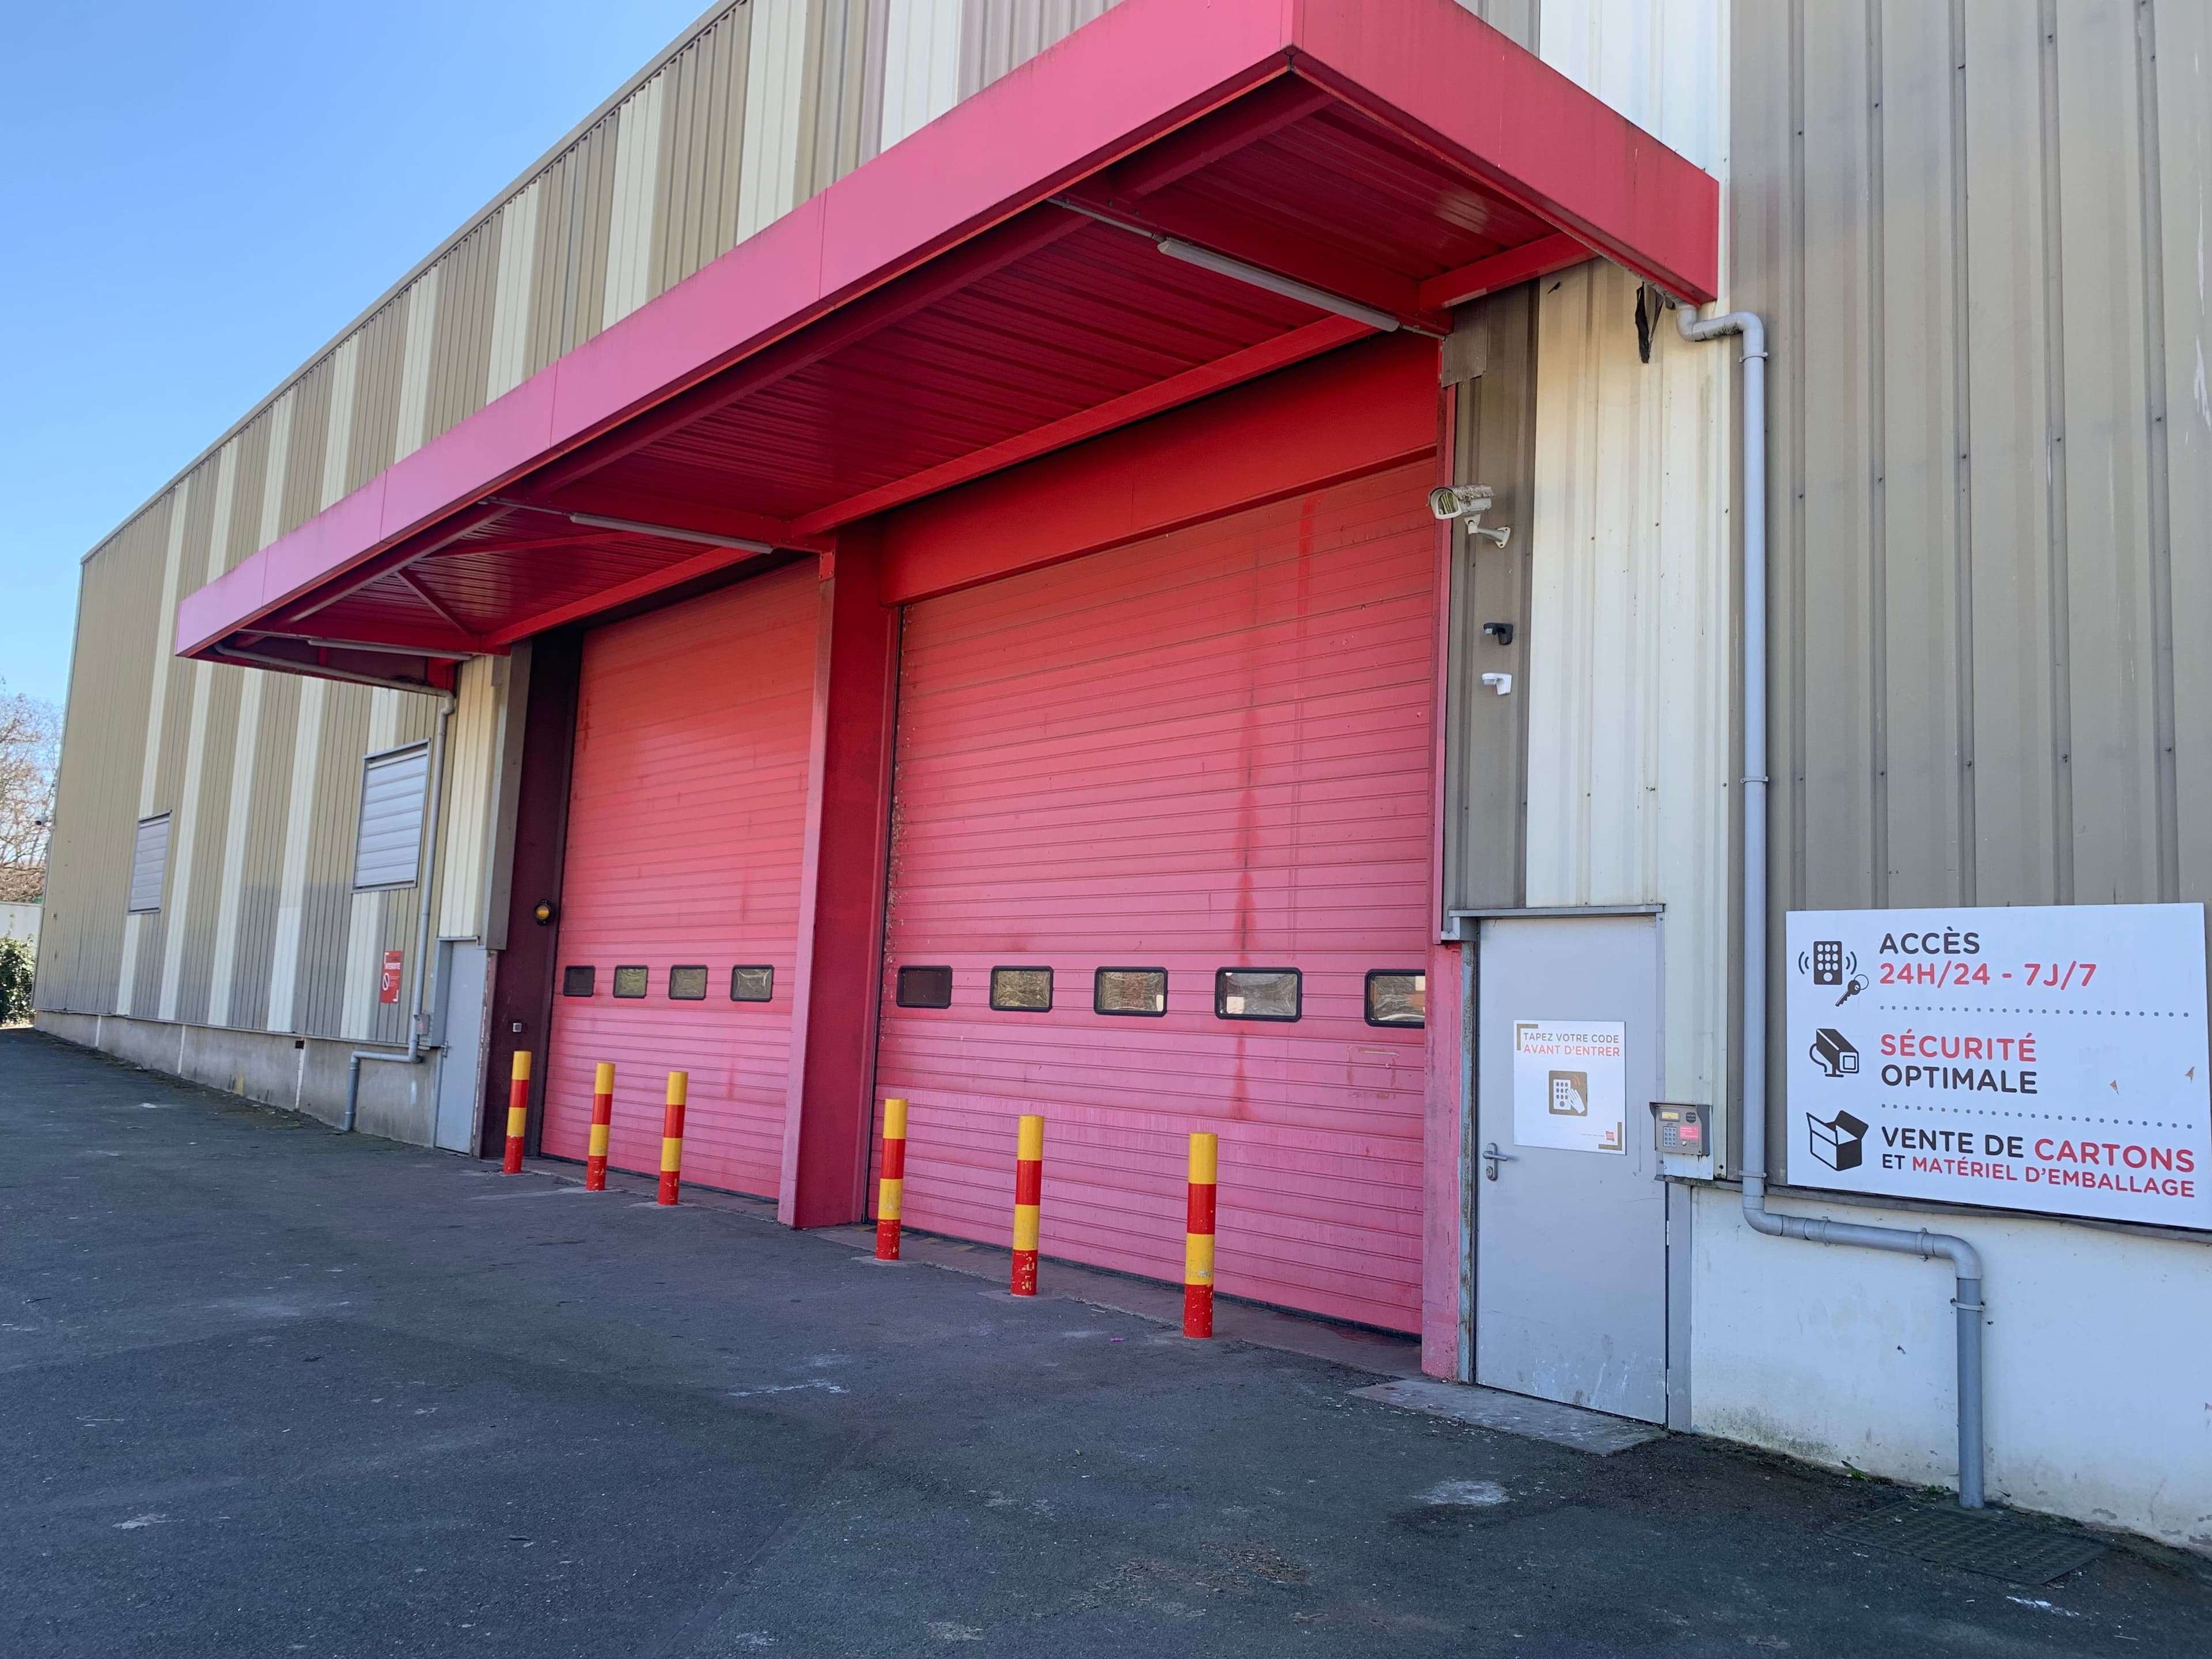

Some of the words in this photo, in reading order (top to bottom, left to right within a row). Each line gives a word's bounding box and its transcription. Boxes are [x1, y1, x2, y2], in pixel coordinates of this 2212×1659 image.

[1879, 926, 1980, 955] ACCÈS
[1879, 960, 1991, 988] 24H/24
[2024, 960, 2097, 990] 7J/7
[1523, 1032, 1554, 1041] TAPEZ
[1555, 1033, 1588, 1043] VOTRE
[1591, 1033, 1619, 1043] CODE
[1523, 1044, 1560, 1054] AVANT
[1565, 1046, 1620, 1057] D'ENTRER
[1880, 1029, 2036, 1062] SÉCURITÉ
[1880, 1064, 2038, 1094] OPTIMALE
[1880, 1126, 1975, 1154] VENTE
[1984, 1134, 2024, 1159] DE
[2035, 1138, 2195, 1173] CARTONS
[1882, 1153, 1906, 1170] ET
[1912, 1156, 2018, 1181] MATÉRIEL
[2025, 1166, 2195, 1199] D'EMBALLAGE
